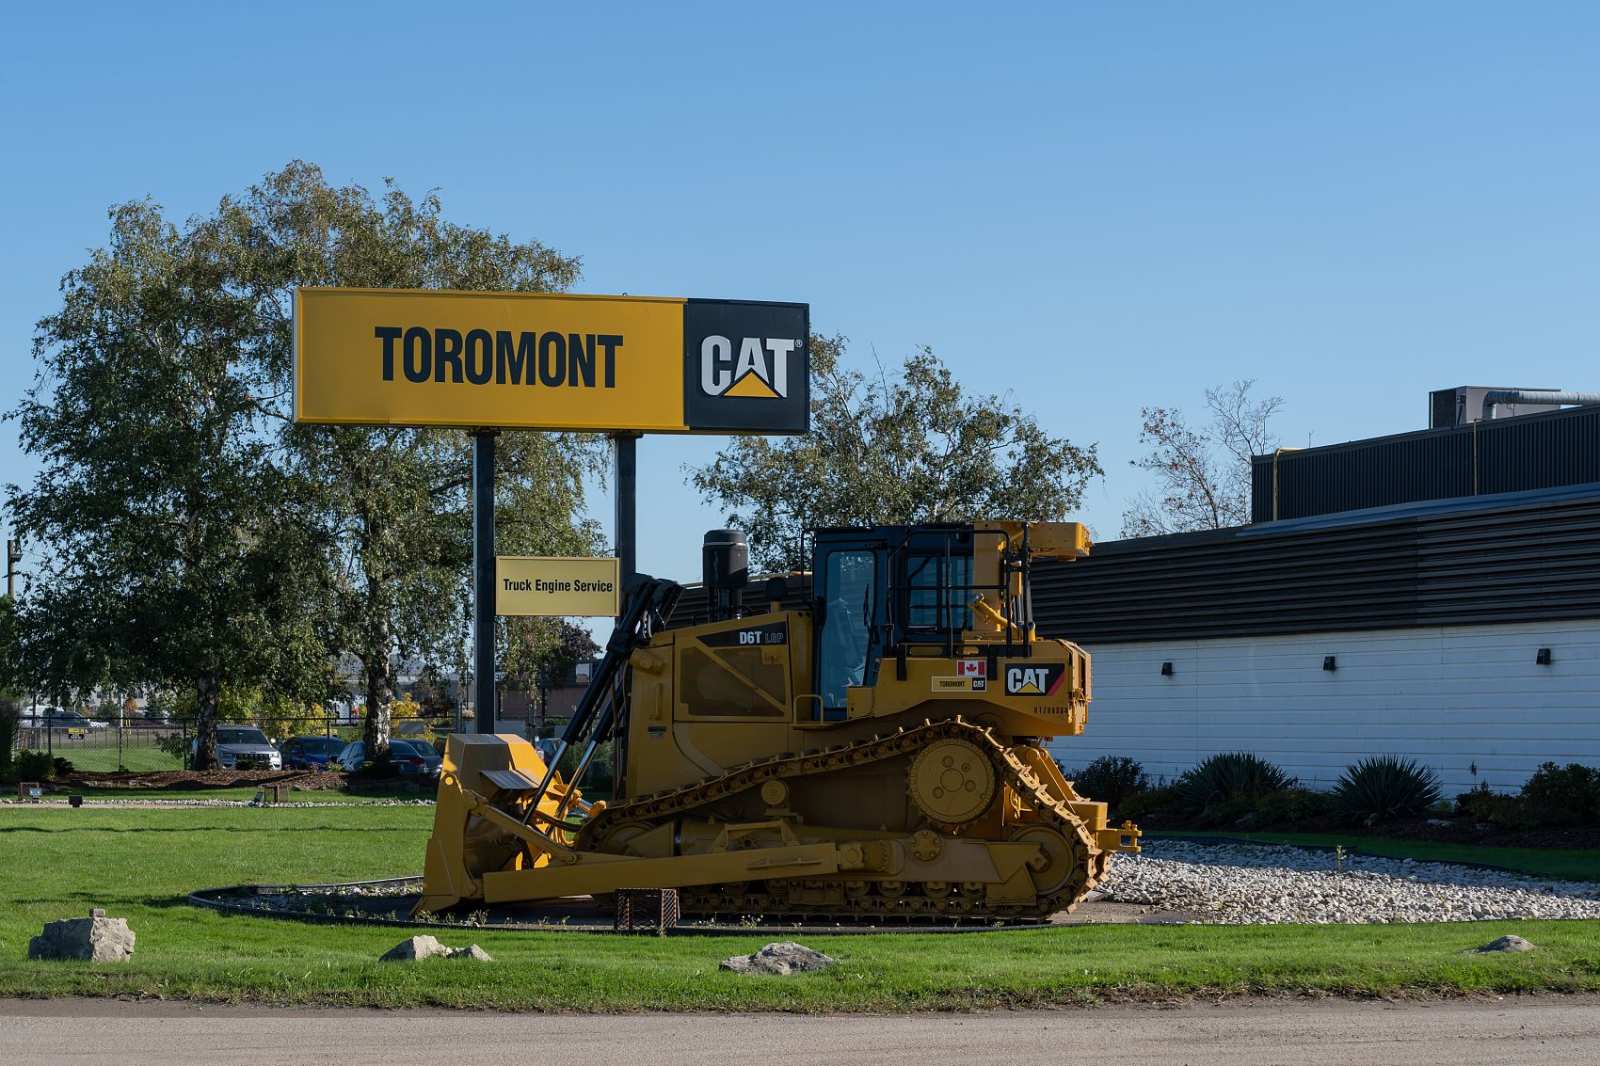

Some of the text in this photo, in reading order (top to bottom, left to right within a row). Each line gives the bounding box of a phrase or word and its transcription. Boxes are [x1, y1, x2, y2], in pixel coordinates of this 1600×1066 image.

[374, 326, 624, 388] TOROMONT
[503, 579, 613, 593] Truck Engine Service
[739, 631, 762, 645] D6T
[1007, 668, 1049, 694] CAT
